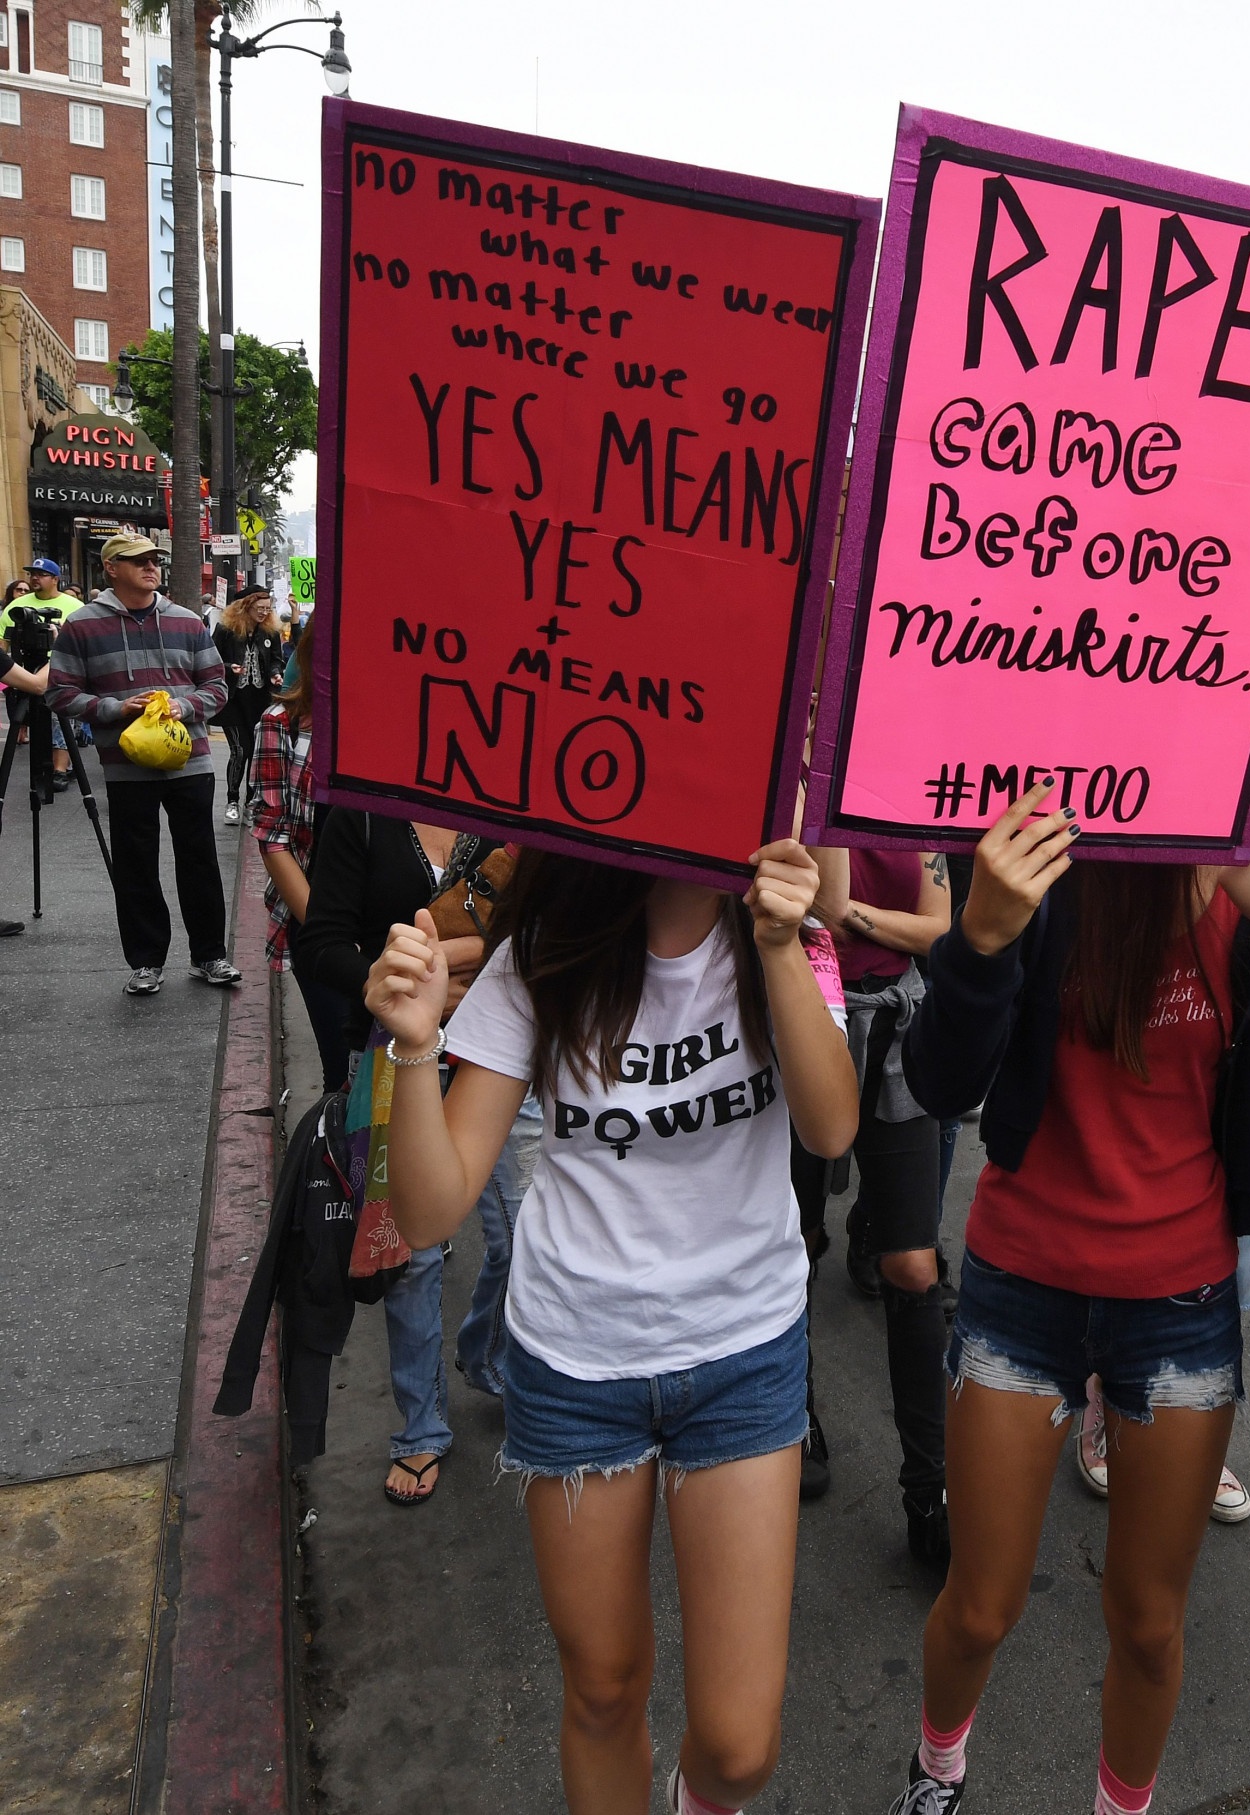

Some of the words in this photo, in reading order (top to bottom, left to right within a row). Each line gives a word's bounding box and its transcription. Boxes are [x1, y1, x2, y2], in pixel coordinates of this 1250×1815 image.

[355, 150, 415, 195] no
[438, 167, 625, 234] matter
[353, 250, 410, 289] no
[428, 269, 632, 338] matter
[481, 229, 610, 275] what
[632, 261, 699, 299] we
[724, 284, 833, 334] wear
[453, 324, 588, 378] where
[615, 361, 688, 398] we
[722, 387, 777, 425] go
[47, 447, 156, 472] WHISTLE
[409, 373, 543, 501] YES
[593, 411, 809, 565] MEANS
[930, 397, 1181, 495] came
[35, 487, 155, 507] RESTAURANT
[509, 510, 646, 617] YES
[392, 617, 467, 664] NO
[507, 647, 705, 723] MEANS
[415, 673, 646, 825] NO
[614, 1021, 739, 1086] GIRL
[554, 1065, 777, 1161] POWER
